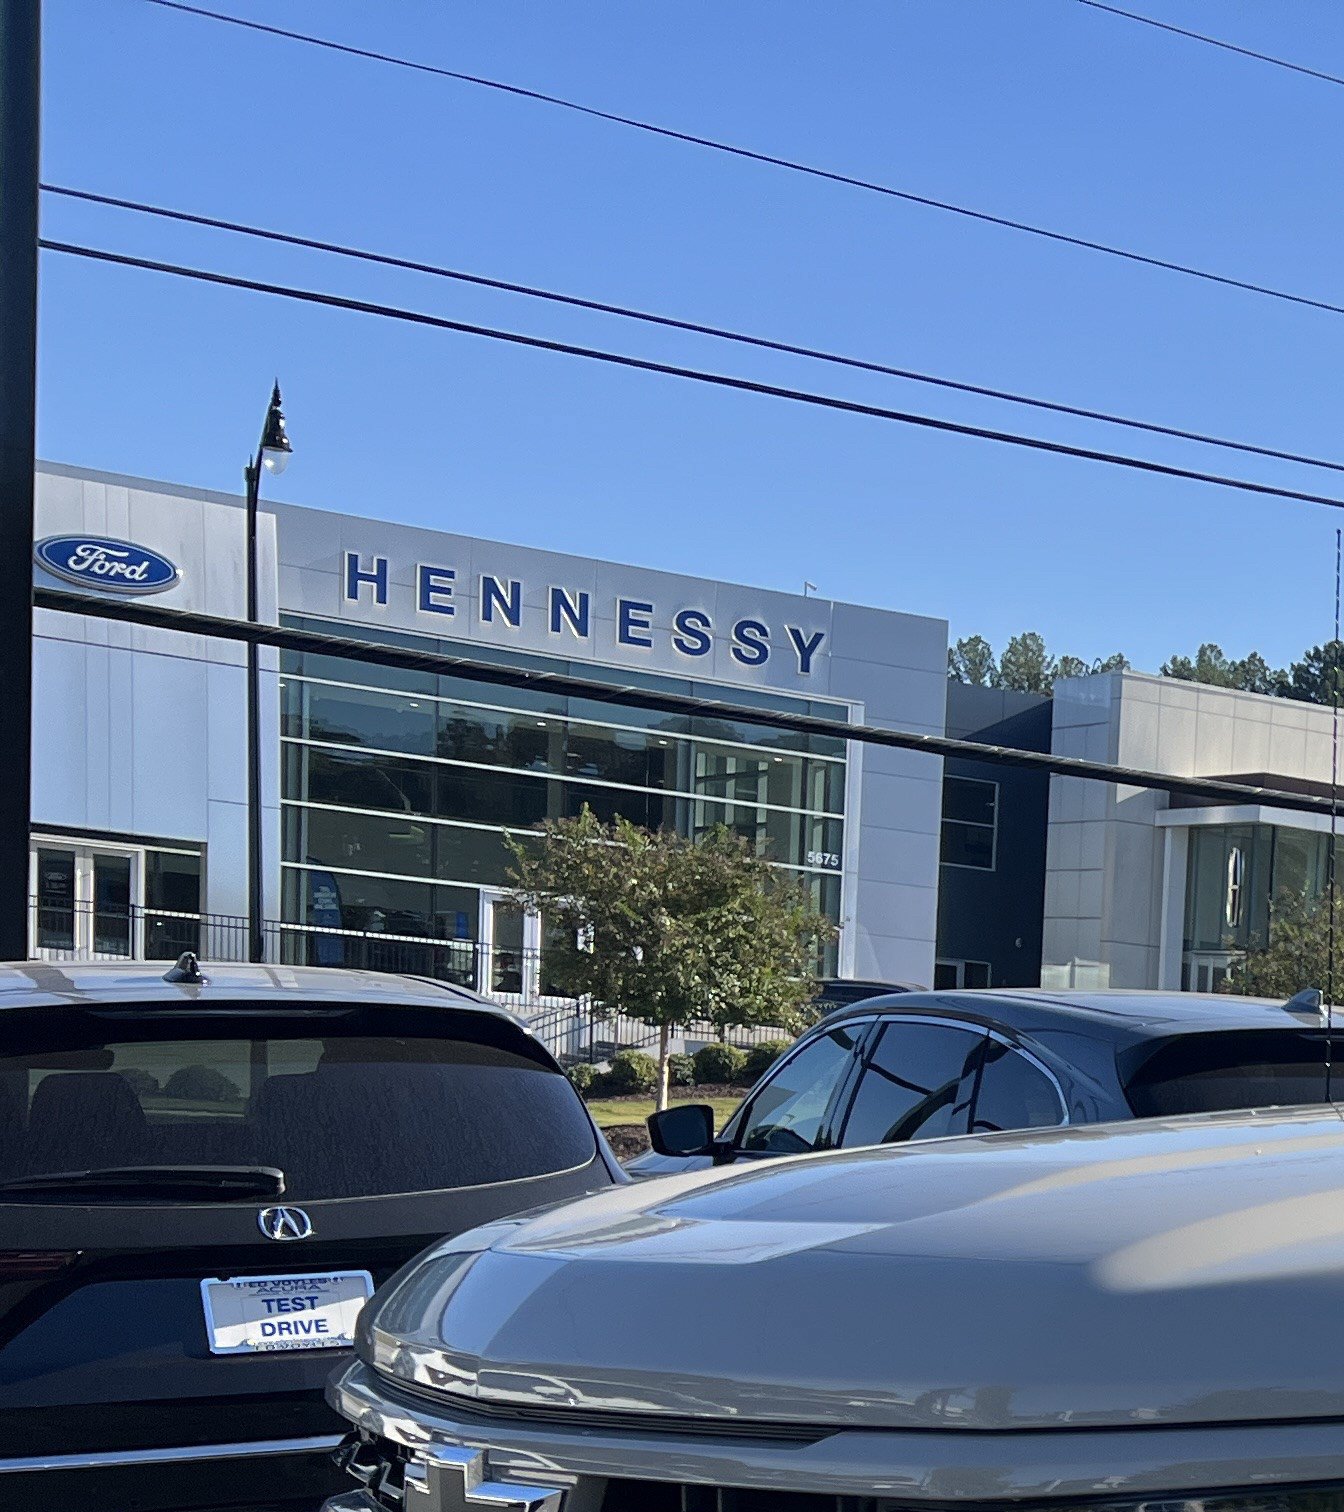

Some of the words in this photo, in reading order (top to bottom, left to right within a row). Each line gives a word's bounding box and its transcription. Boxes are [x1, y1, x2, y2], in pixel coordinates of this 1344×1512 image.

[67, 544, 150, 581] Ford
[343, 550, 825, 674] HENNESSY
[807, 850, 839, 867] 5675
[256, 1284, 321, 1294] ACURA
[262, 1296, 318, 1314] TEST
[260, 1319, 329, 1337] DRIVE
